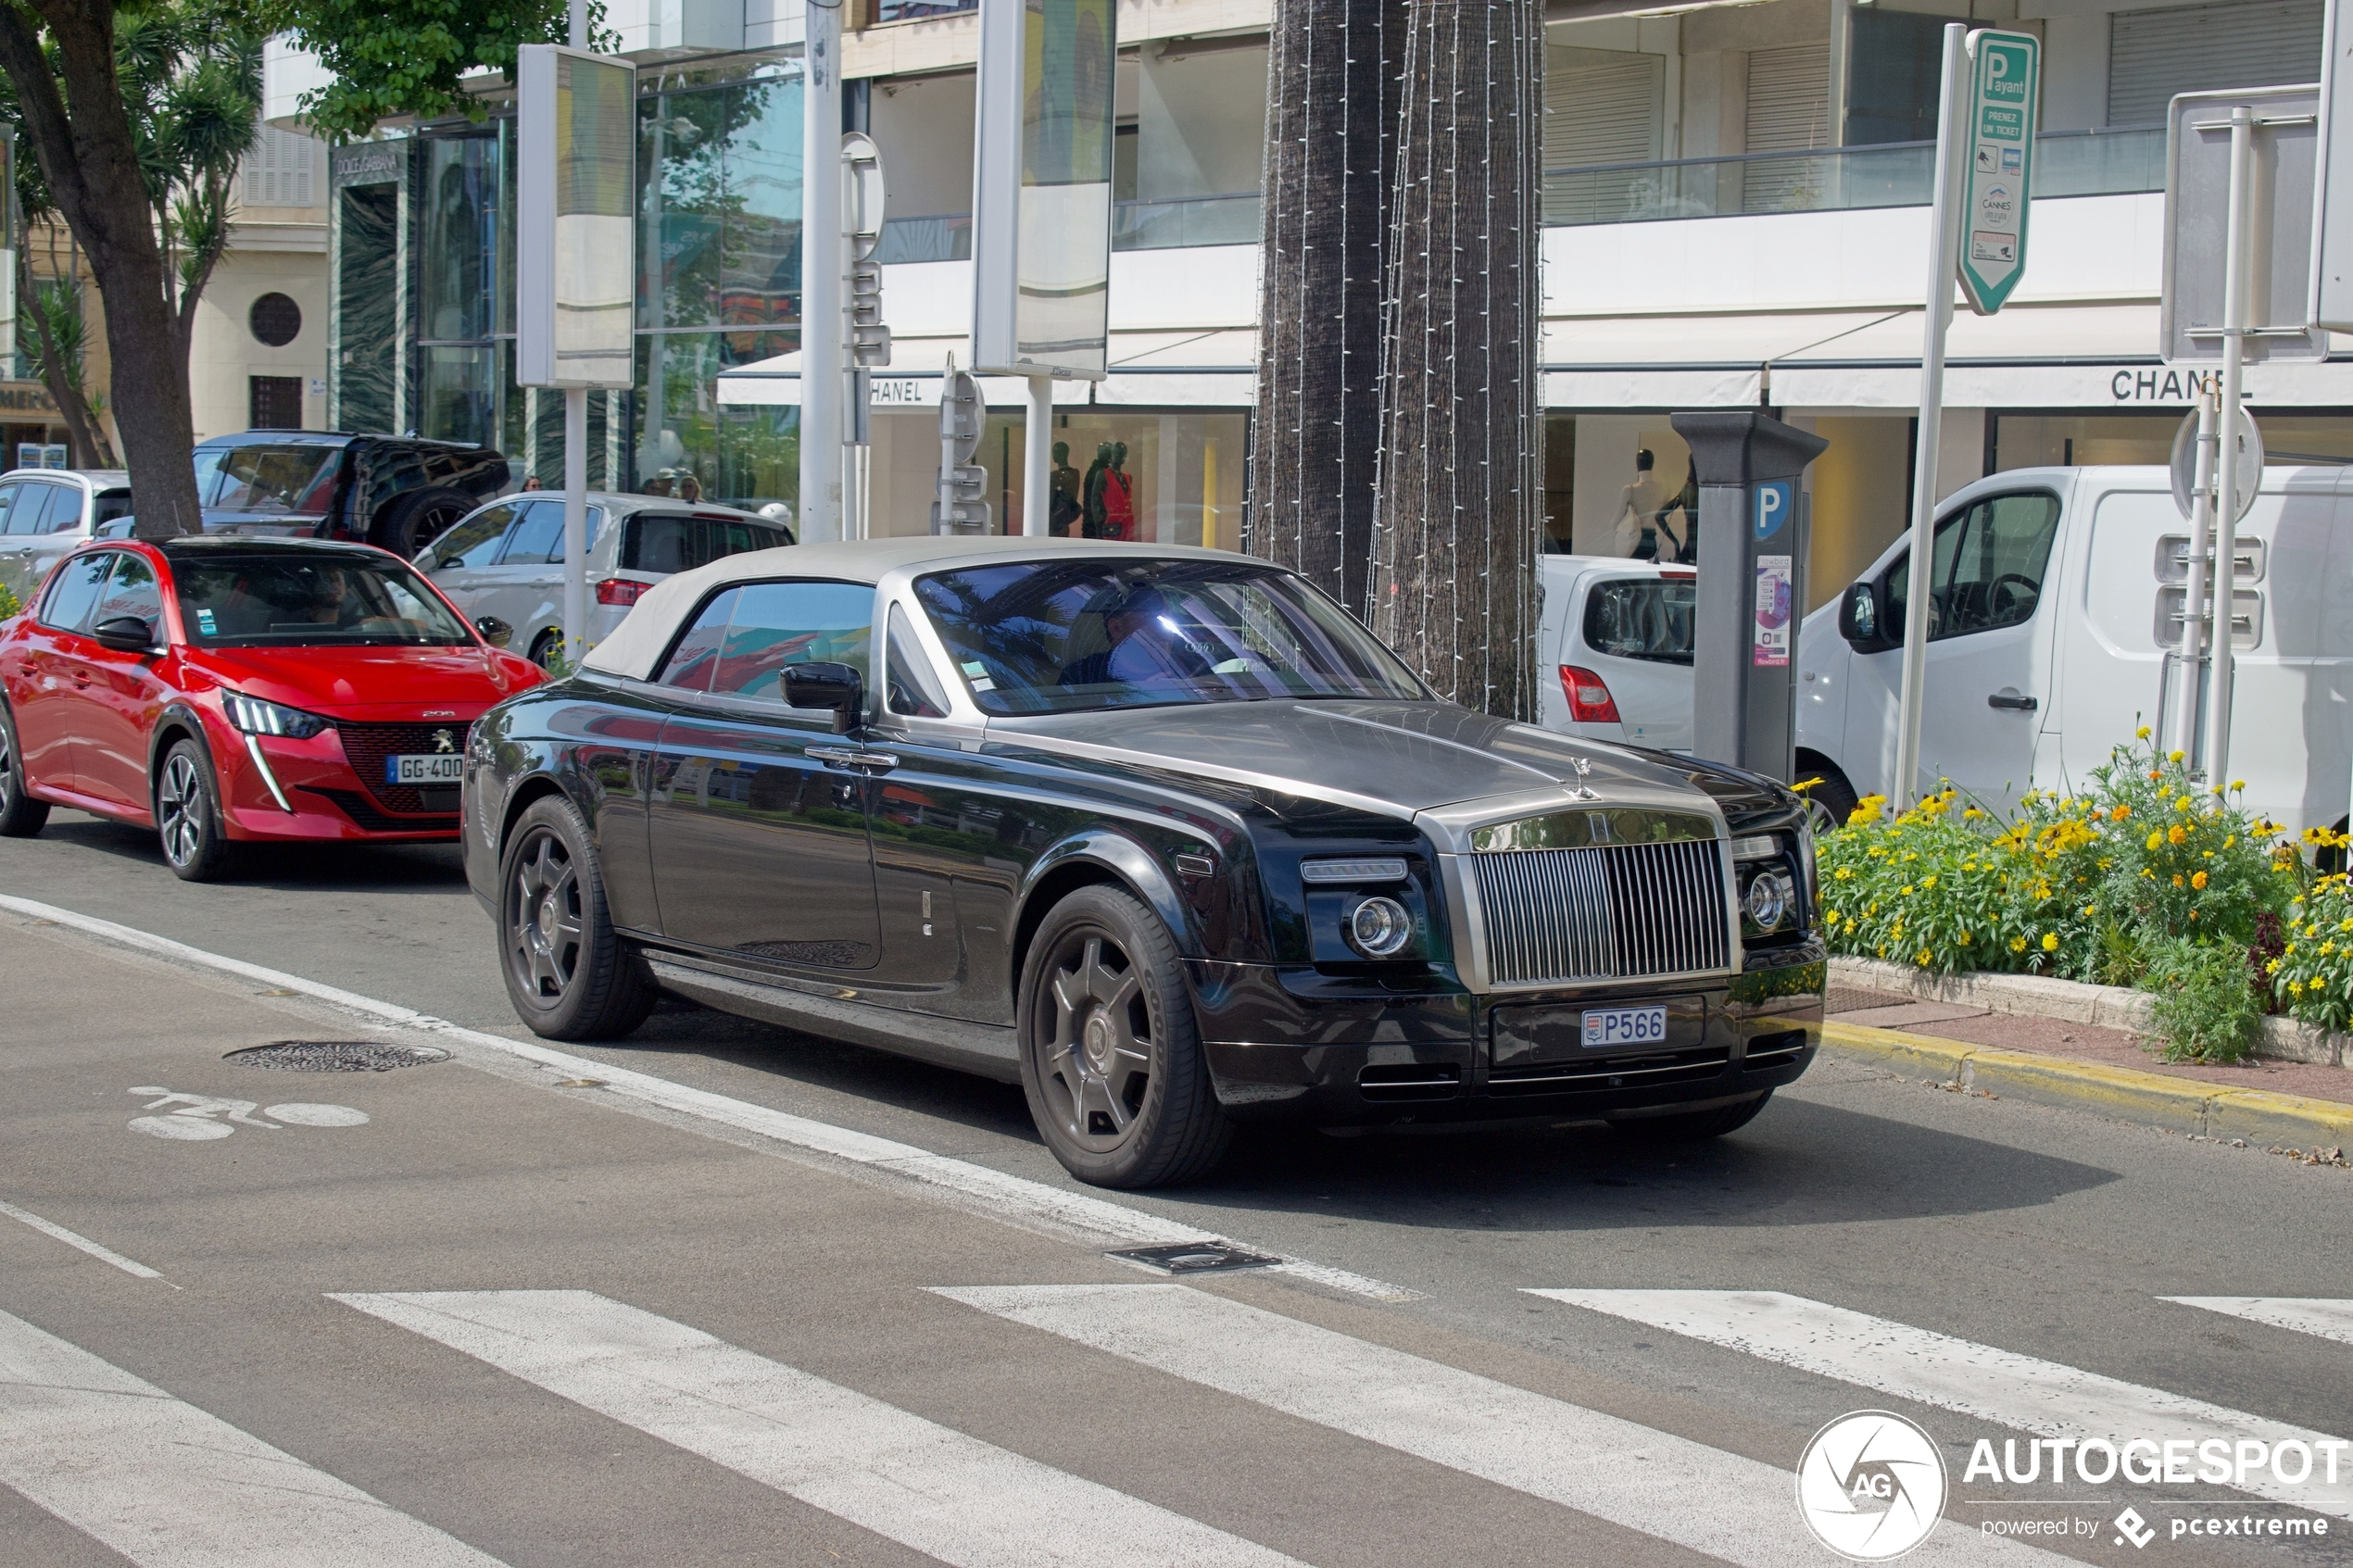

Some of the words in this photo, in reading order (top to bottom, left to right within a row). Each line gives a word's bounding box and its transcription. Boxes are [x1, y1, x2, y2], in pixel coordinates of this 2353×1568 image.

[1986, 52, 2024, 94] Payant
[1988, 111, 2017, 123] PRENEZ
[1982, 123, 1994, 134] UN
[1995, 125, 2020, 137] TICKET
[1982, 199, 2011, 211] CANNES
[1974, 232, 2015, 244] ATTENTION
[871, 382, 922, 402] HANEL
[2111, 370, 2253, 400] CHAN
[1759, 487, 1780, 528] P
[1758, 557, 1790, 565] flowbird
[1604, 1011, 1662, 1041] P566
